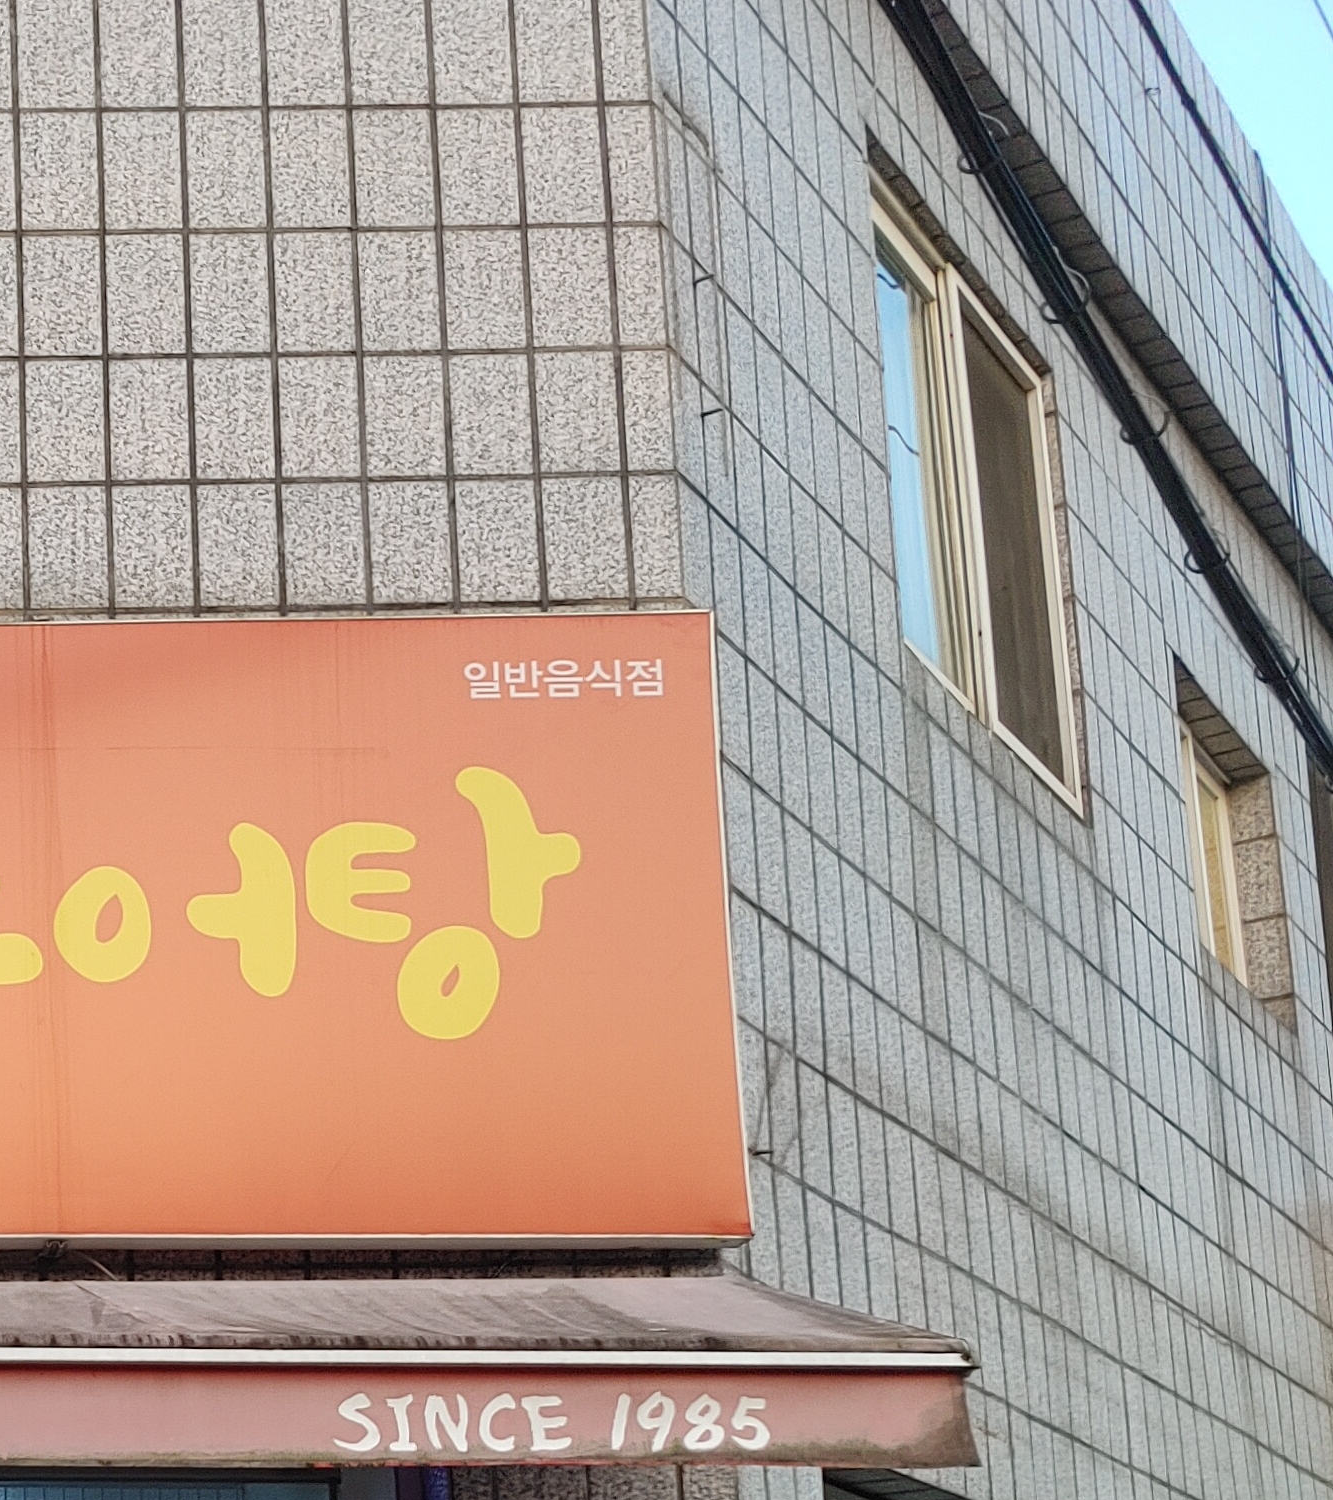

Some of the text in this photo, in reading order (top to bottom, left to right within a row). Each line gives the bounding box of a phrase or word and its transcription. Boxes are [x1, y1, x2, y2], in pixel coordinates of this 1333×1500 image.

[463, 658, 664, 699] 일반음식점
[333, 1391, 771, 1453] SINCE 1985
